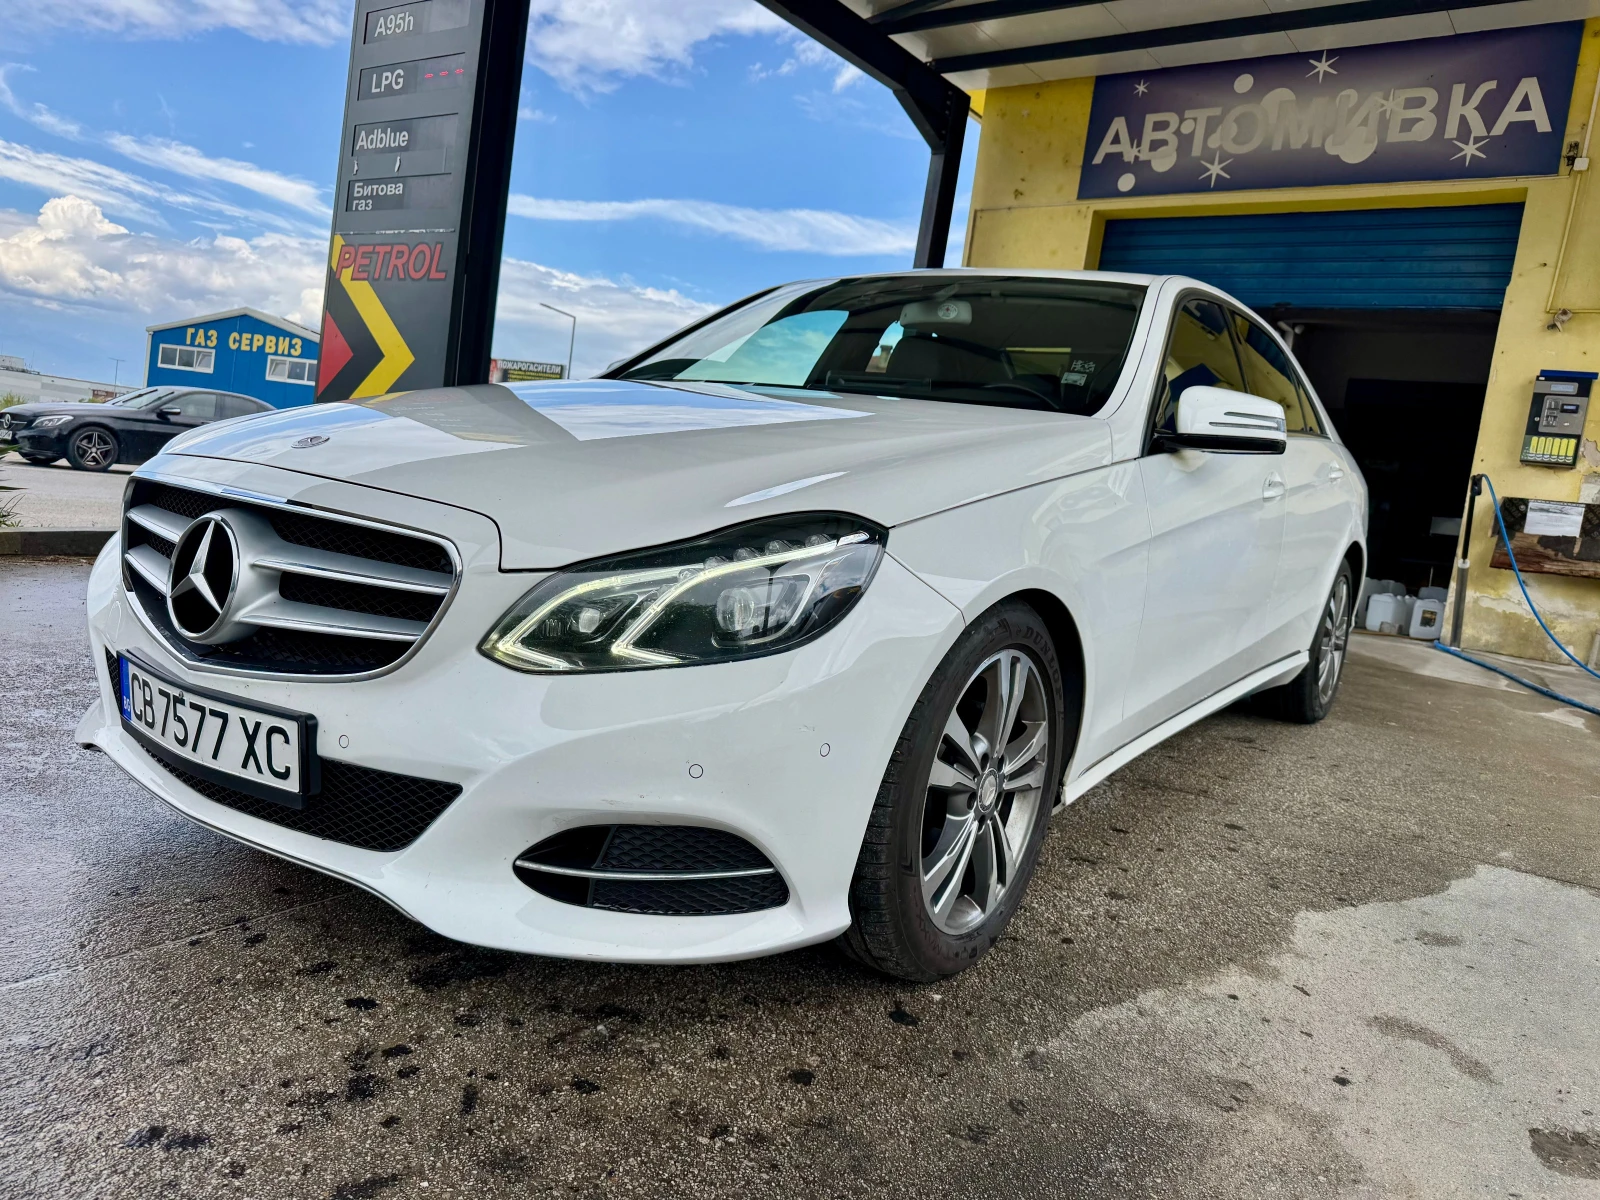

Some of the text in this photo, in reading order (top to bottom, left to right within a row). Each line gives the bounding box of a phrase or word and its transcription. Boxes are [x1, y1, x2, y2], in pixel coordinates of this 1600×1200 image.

[374, 11, 414, 37] A95h
[371, 69, 404, 93] LPG
[1092, 76, 1553, 165] АВТОМИВКА
[356, 128, 409, 150] Adblue
[353, 182, 404, 197] Битова
[352, 199, 373, 211] газ
[335, 243, 447, 280] PETROL
[186, 328, 303, 356] ГАЗ СЕРВИЗ
[497, 360, 562, 374] ПОЖАРОГАСИТЕЛИ
[1022, 625, 1063, 701] DUNLOP
[131, 672, 291, 781] CB 7577 XC
